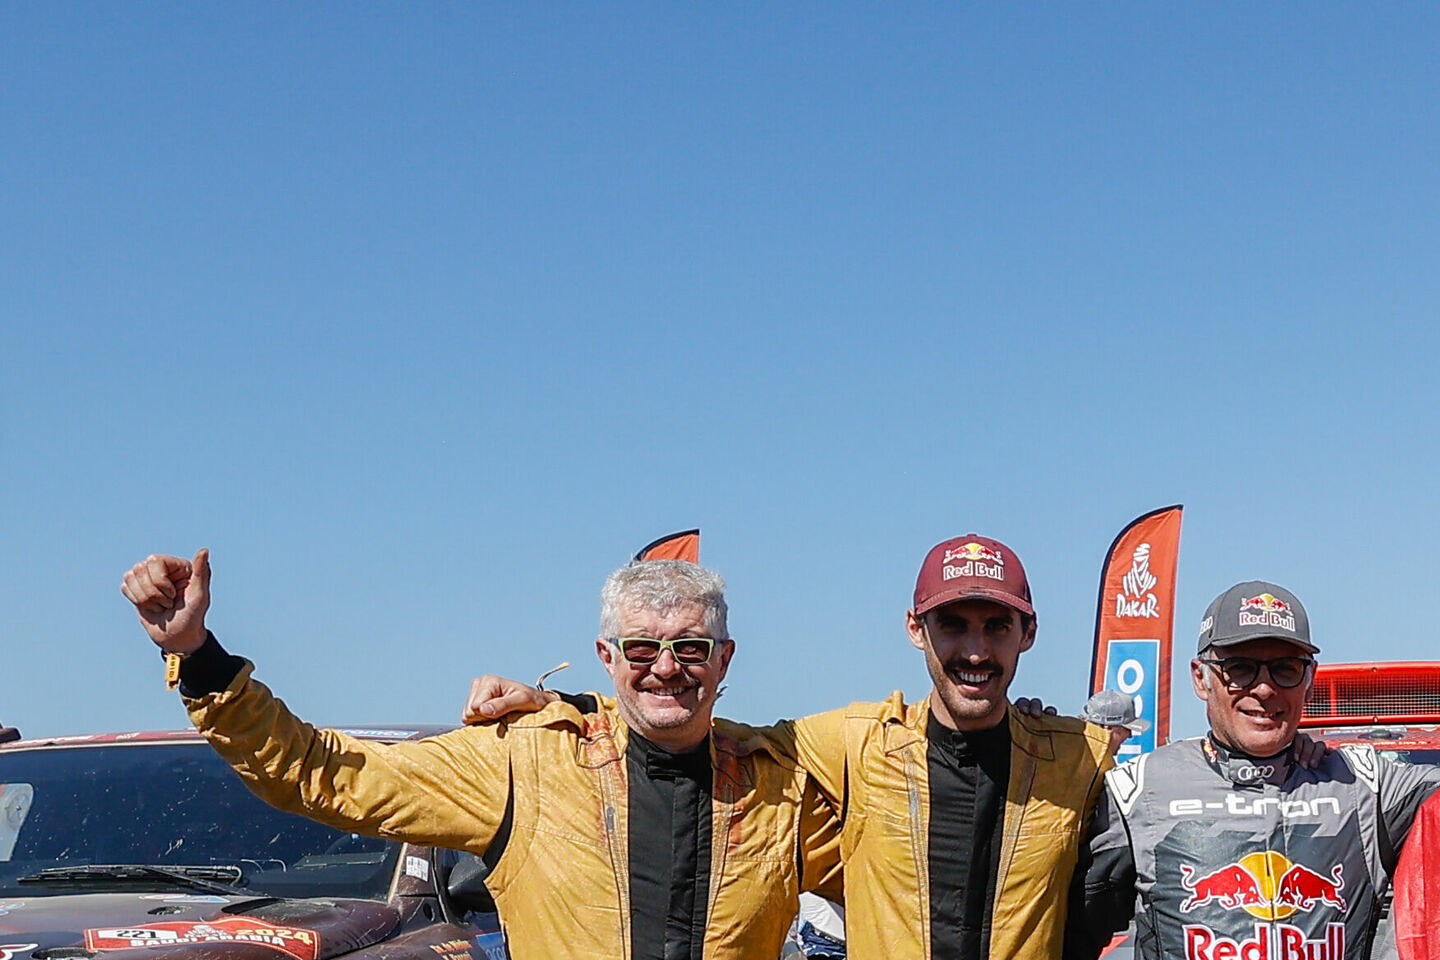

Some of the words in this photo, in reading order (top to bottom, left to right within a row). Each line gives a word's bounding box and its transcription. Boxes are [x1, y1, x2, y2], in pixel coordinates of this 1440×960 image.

[943, 561, 973, 581] Red
[975, 561, 1004, 581] Bull
[1116, 593, 1160, 618] DAKAR
[1239, 611, 1269, 626] Red
[1270, 612, 1296, 632] Bull
[1170, 793, 1341, 818] e-tron
[117, 929, 157, 940] 221
[236, 928, 314, 945] 2024
[130, 938, 205, 948] SAUDI
[211, 934, 287, 947] ARABIA
